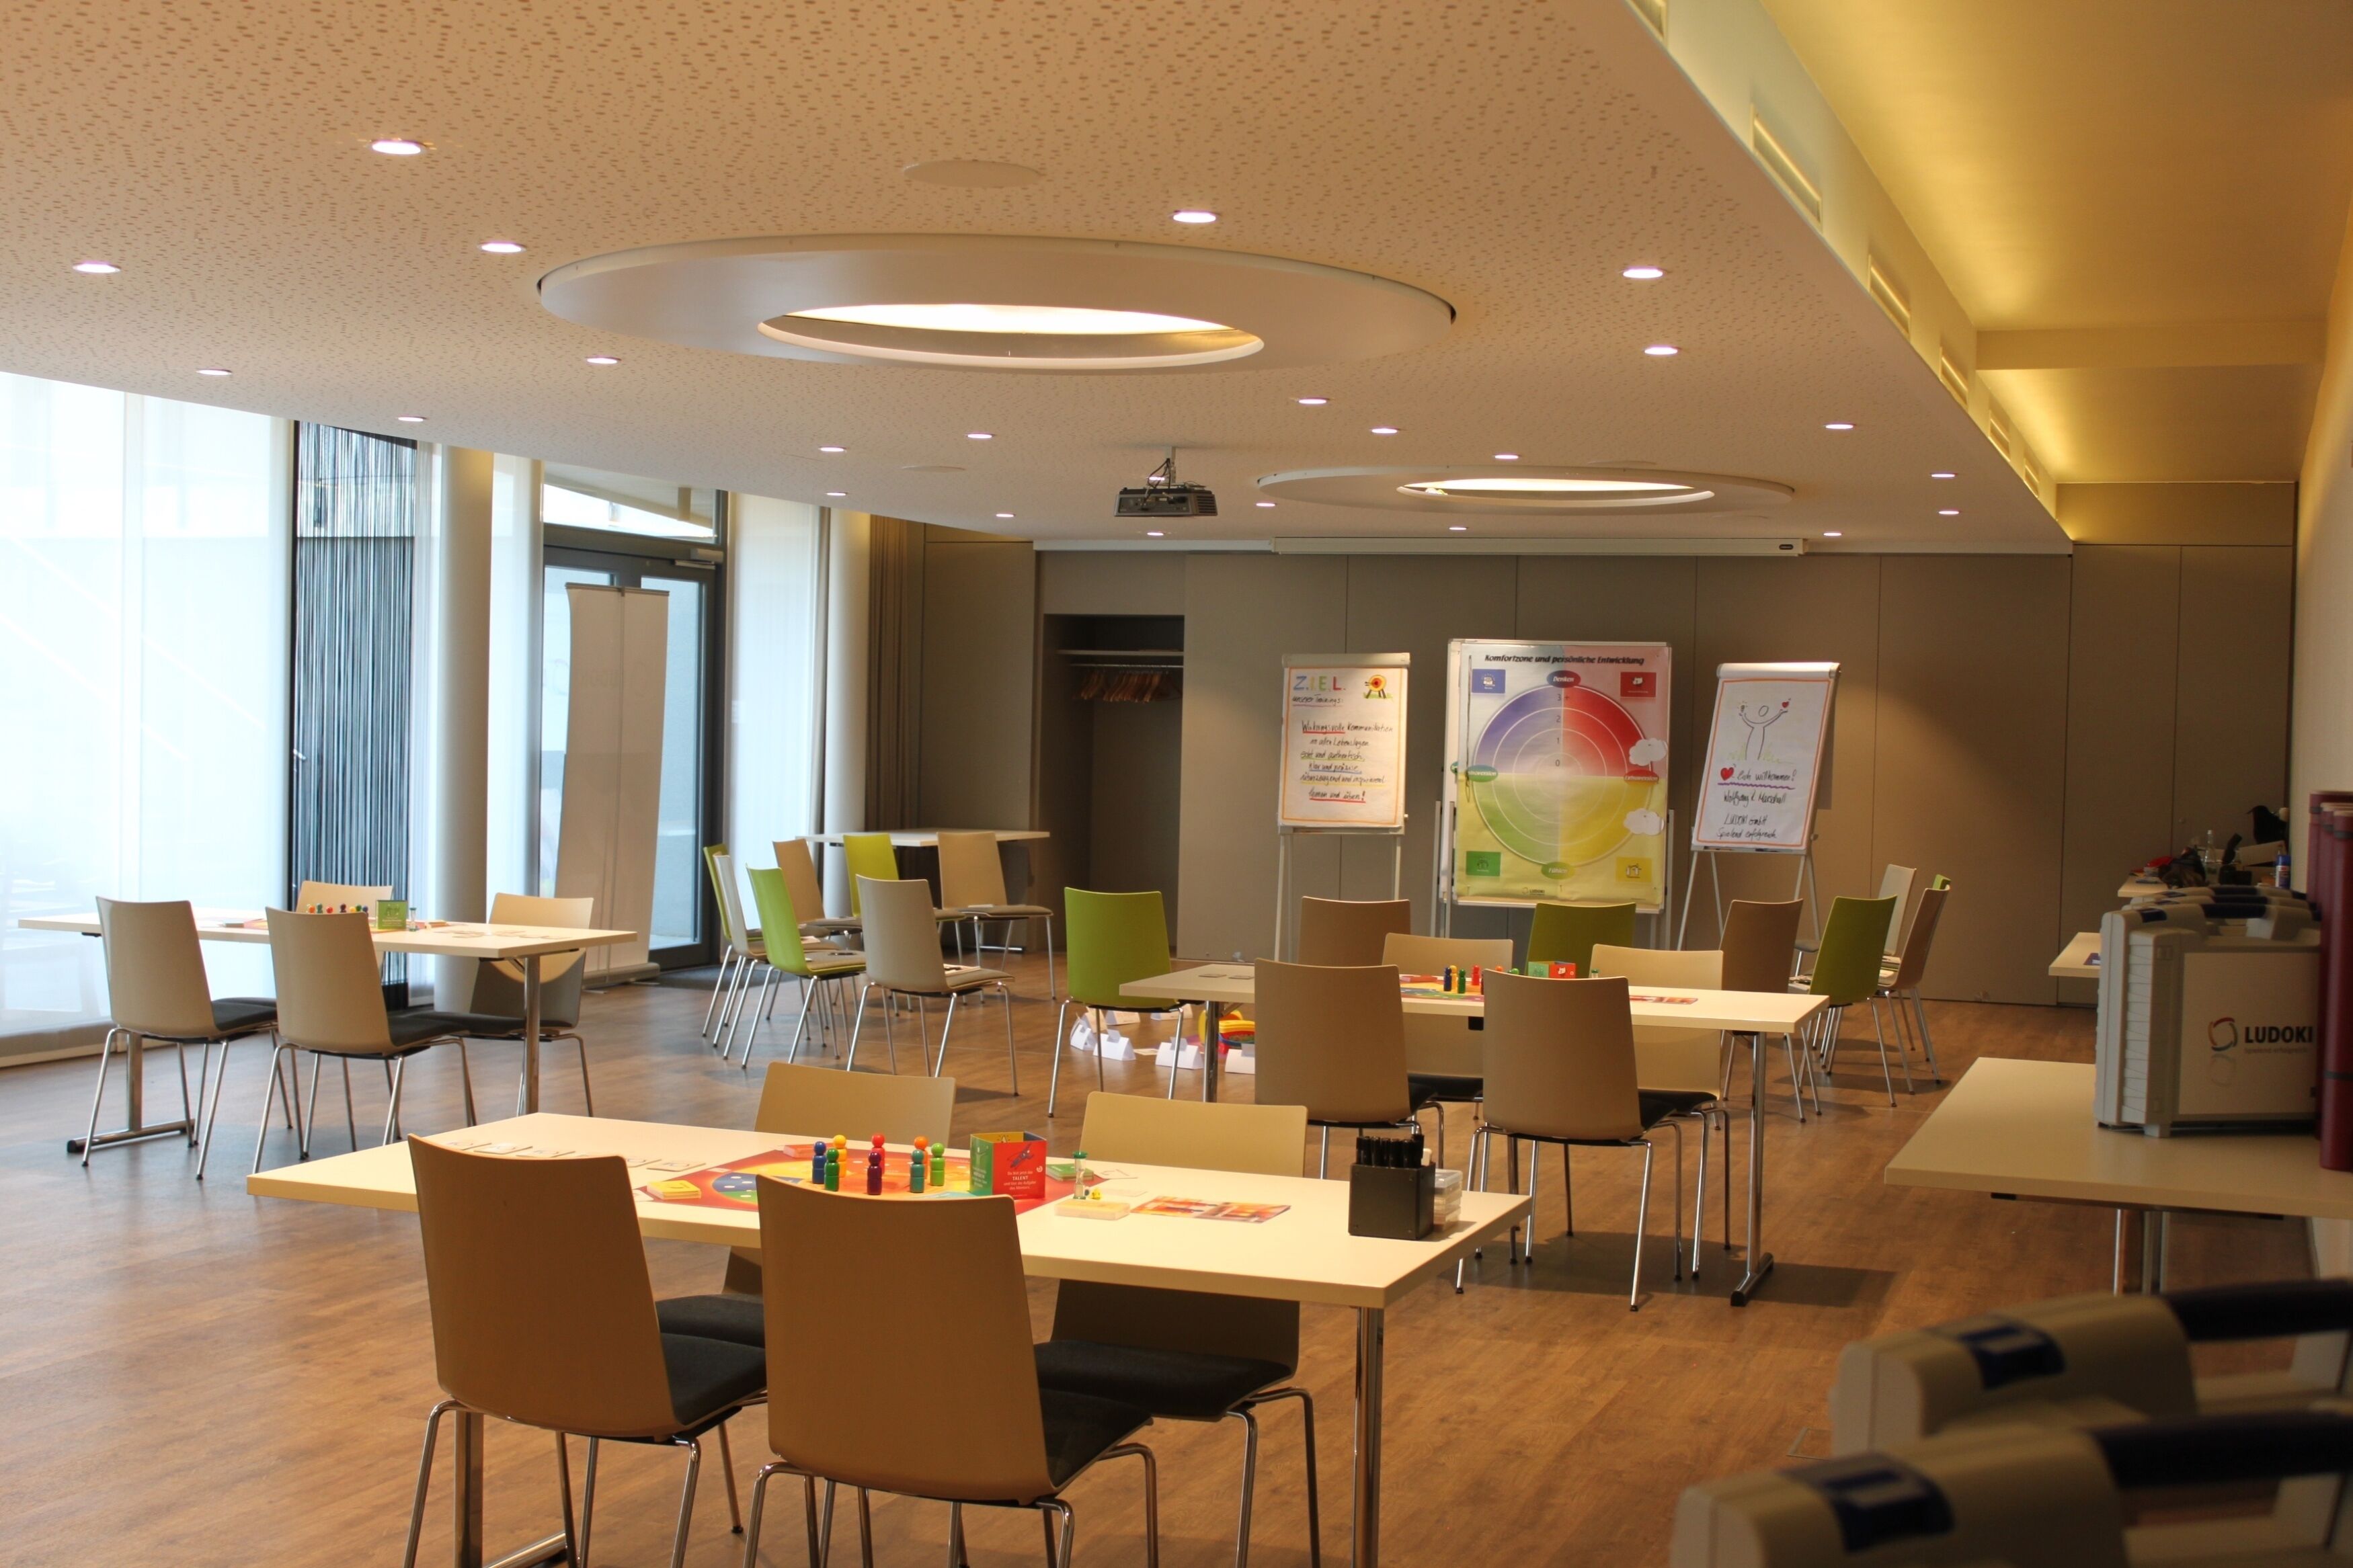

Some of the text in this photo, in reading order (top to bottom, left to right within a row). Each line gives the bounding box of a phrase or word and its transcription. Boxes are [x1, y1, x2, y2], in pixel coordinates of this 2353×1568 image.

[1551, 656, 1596, 664] persönliche
[1597, 657, 1645, 665] Entwicklung
[2245, 1026, 2314, 1044] LUDOKI
